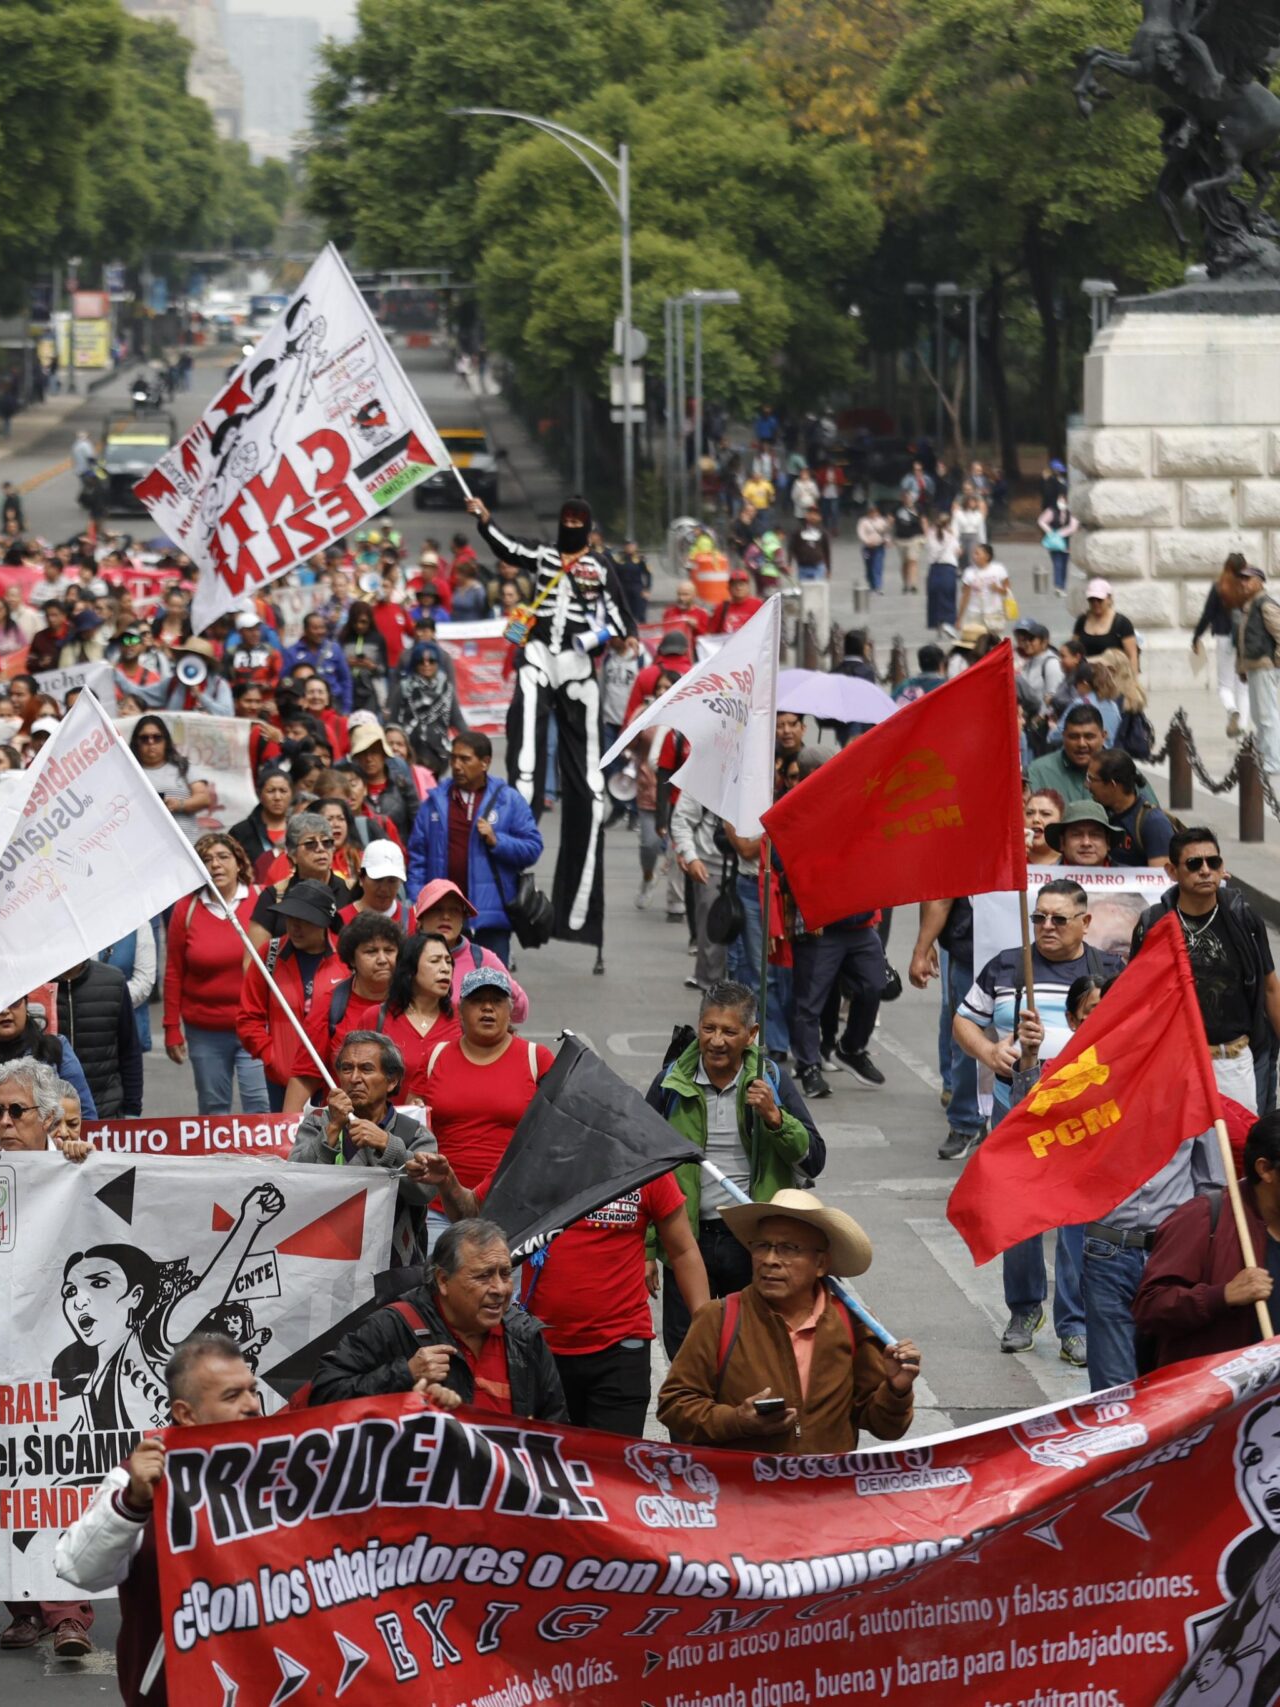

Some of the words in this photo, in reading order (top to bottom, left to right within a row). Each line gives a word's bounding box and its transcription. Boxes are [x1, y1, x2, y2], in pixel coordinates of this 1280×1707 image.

[881, 804, 964, 842] PCM
[1027, 873, 1053, 885] EDA
[1065, 873, 1125, 886] CHARRO
[1135, 874, 1166, 886] TRA
[90, 1121, 168, 1153] rturo
[1027, 1098, 1122, 1159] PCM
[586, 1211, 638, 1222] ENSEÑANDO
[234, 1261, 274, 1294] CNTE
[1095, 1403, 1130, 1423] 10
[166, 1410, 610, 1554] PRESIDENTA:
[858, 1468, 970, 1495] DEMOCRÁTICA
[635, 1495, 718, 1528] CNTE
[172, 1580, 261, 1651] ¿Con
[260, 1566, 311, 1626] los
[307, 1535, 526, 1608] trabajadores
[528, 1556, 564, 1590] o
[564, 1556, 659, 1598] con
[656, 1553, 731, 1599] los
[728, 1631, 780, 1659] acoso
[858, 1594, 994, 1637] autoritarismo
[996, 1595, 1010, 1627] y
[1013, 1583, 1069, 1617] falsas
[1072, 1570, 1200, 1608] acusaciones.
[532, 1668, 551, 1702] de
[551, 1661, 573, 1694] 90
[576, 1656, 619, 1690] días.
[815, 1666, 876, 1699] buena
[880, 1664, 894, 1698] y
[897, 1655, 959, 1687] barata
[963, 1647, 1005, 1685] para
[1010, 1640, 1038, 1670] los
[1041, 1624, 1175, 1667] trabajadores.
